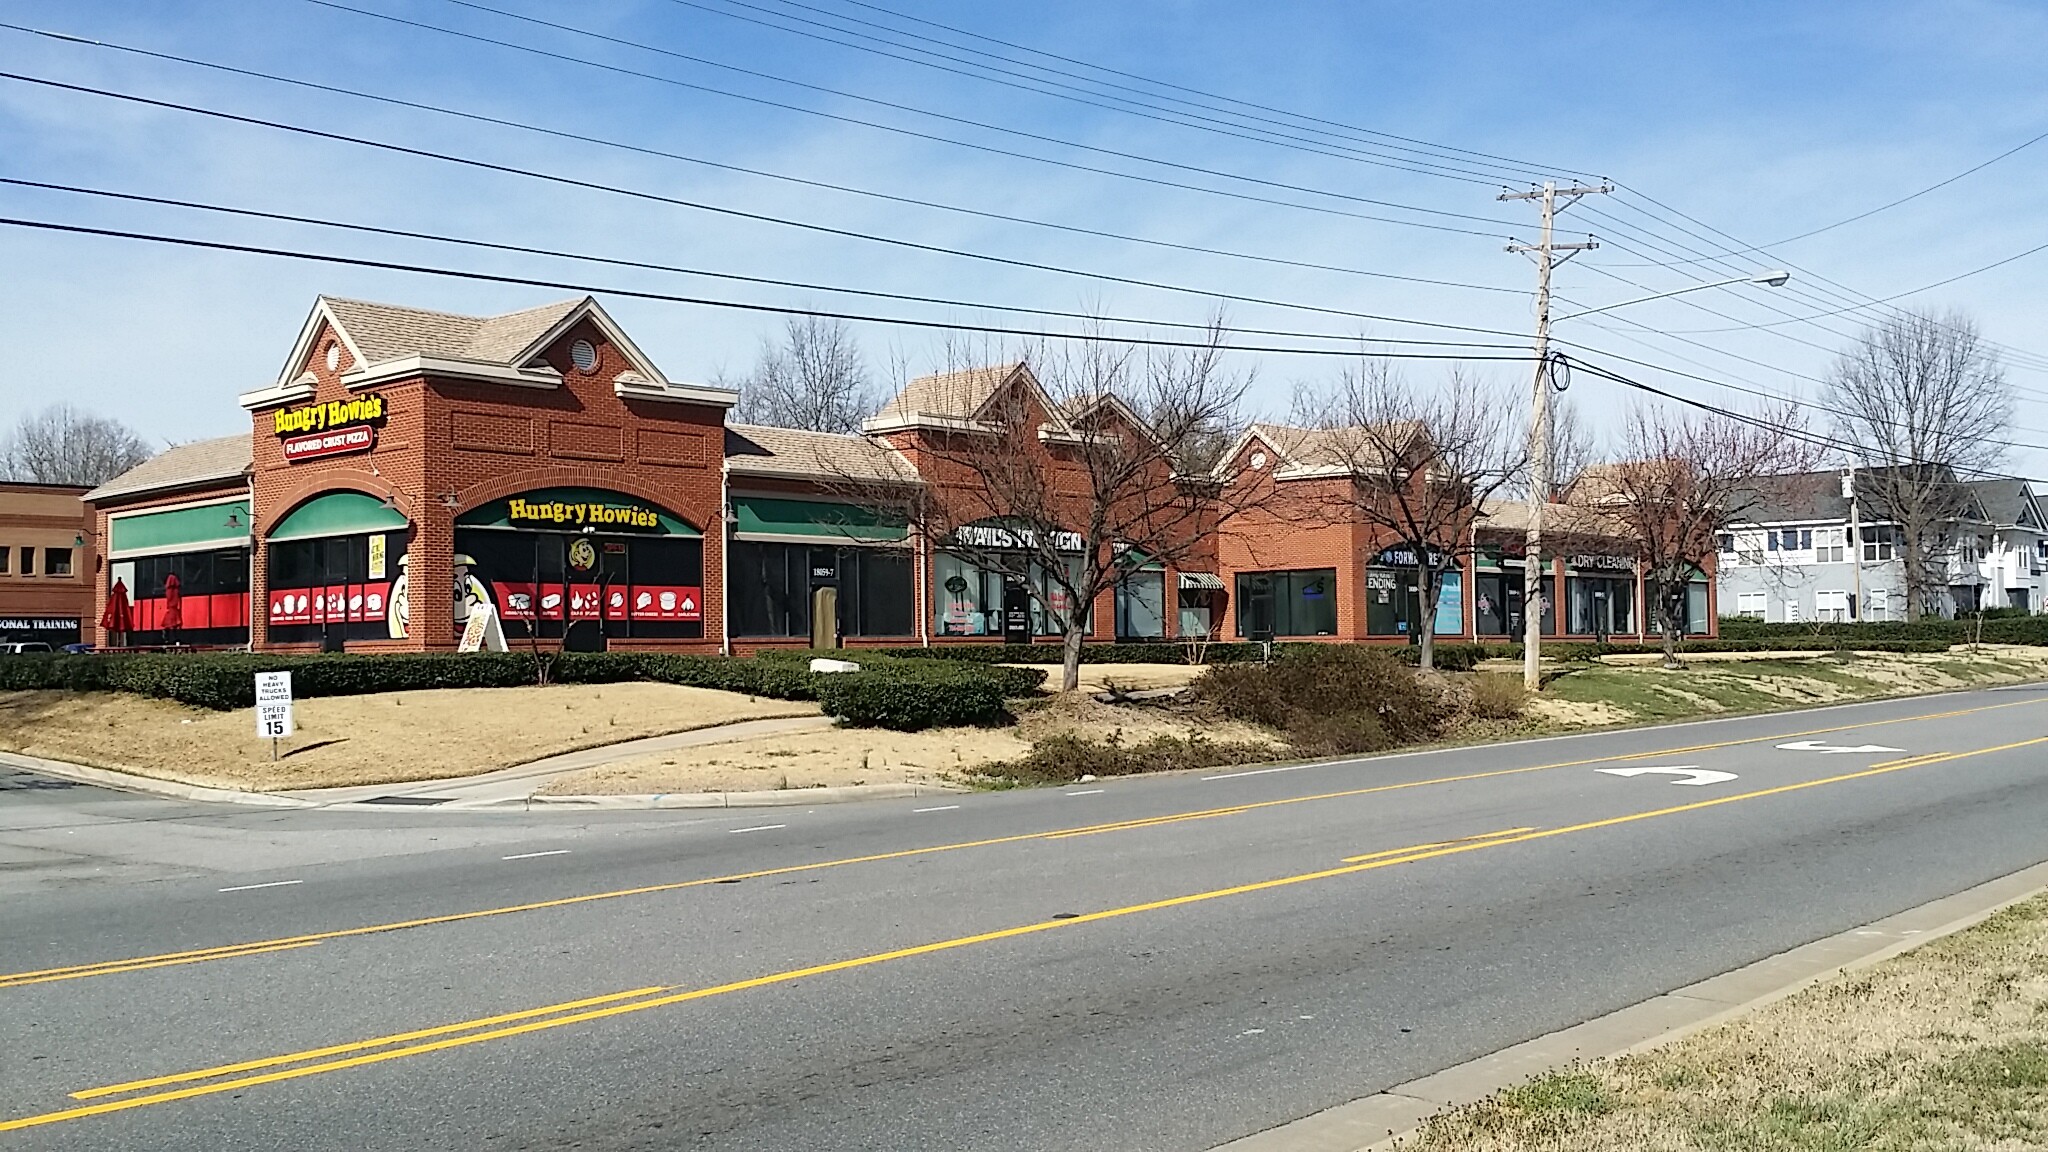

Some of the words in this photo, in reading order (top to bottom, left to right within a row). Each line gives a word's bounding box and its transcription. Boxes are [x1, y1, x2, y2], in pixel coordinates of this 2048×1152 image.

[275, 403, 327, 433] Hungry
[328, 393, 382, 426] Howie's
[286, 439, 322, 455] FLAVORED
[323, 434, 346, 448] CRUST
[346, 430, 369, 444] PIZZA
[509, 499, 587, 524] Hungry
[589, 505, 658, 527] Howie's
[1577, 554, 1594, 569] DRY
[1597, 555, 1635, 571] CLEANING
[32, 619, 78, 630] TRAINING
[262, 706, 286, 714] SPEED
[264, 713, 284, 721] LIMIT
[266, 720, 284, 735] 15
